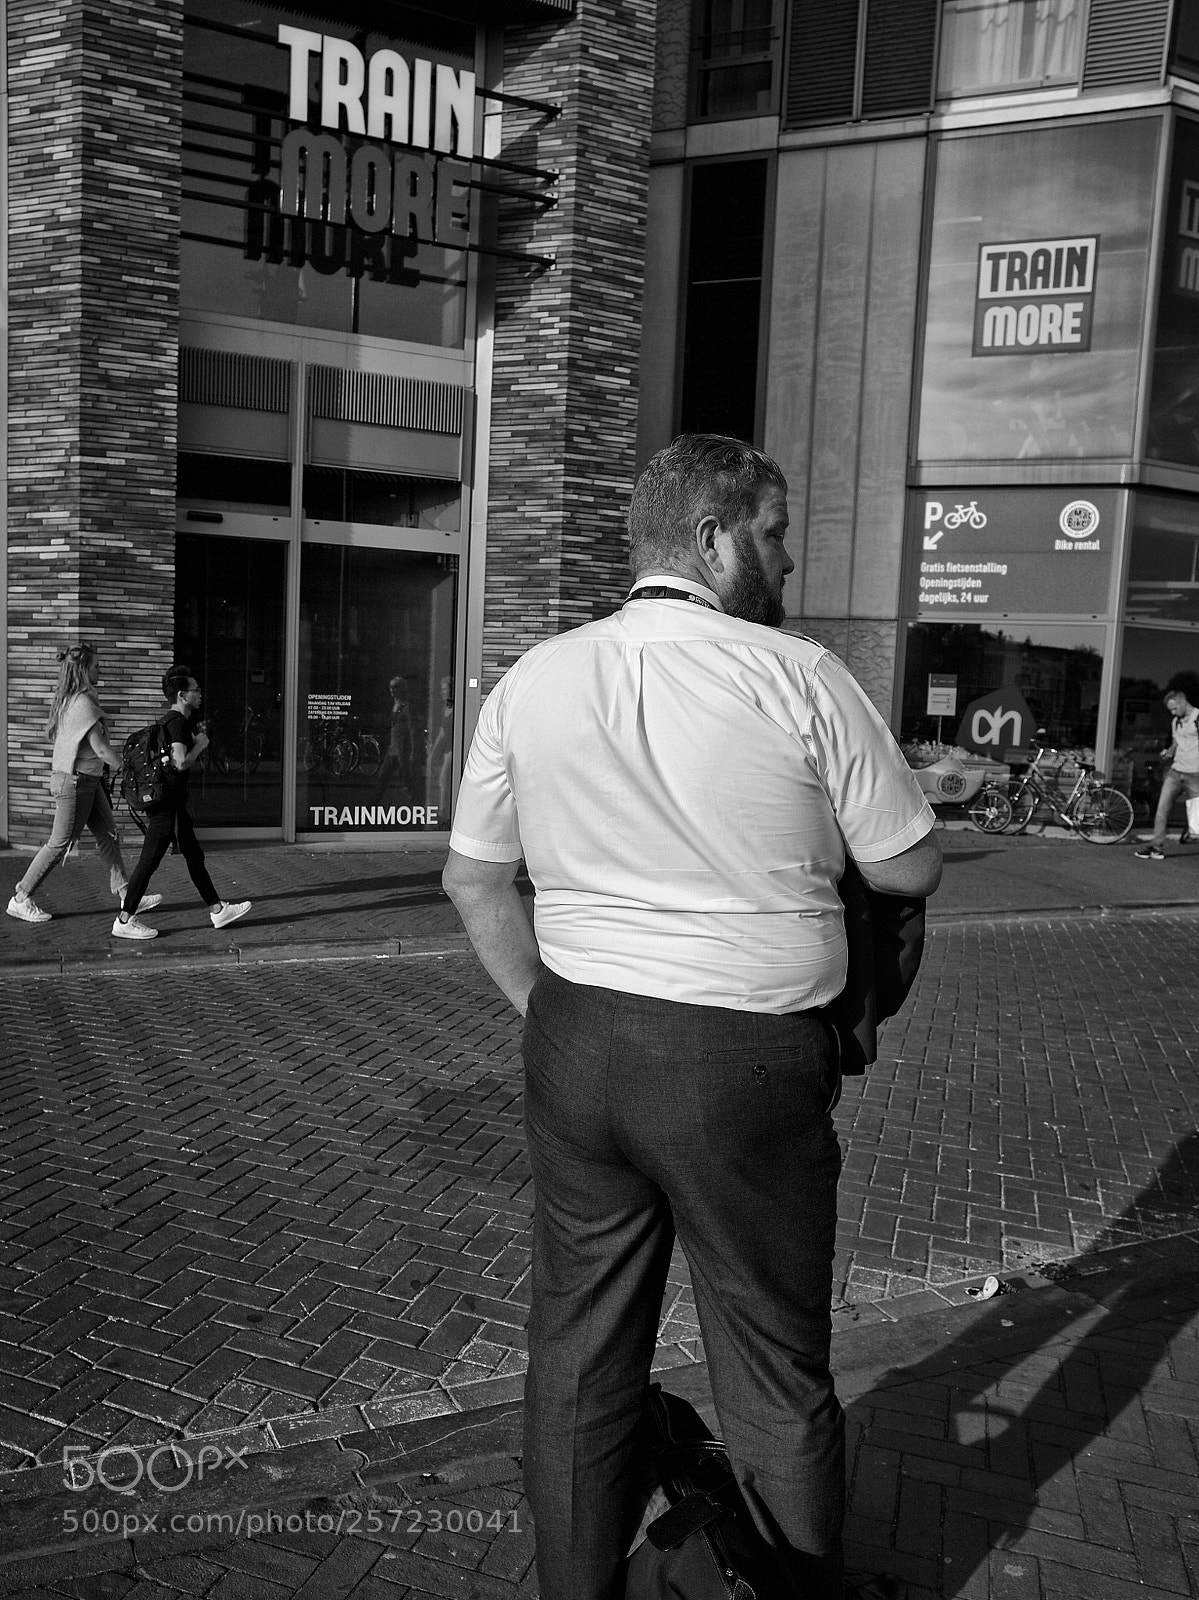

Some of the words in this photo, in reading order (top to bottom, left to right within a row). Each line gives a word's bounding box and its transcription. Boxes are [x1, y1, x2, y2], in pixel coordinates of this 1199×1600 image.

[278, 24, 475, 159] TRAIN
[280, 129, 472, 244] MORE
[986, 245, 1089, 293] TRAIN
[982, 302, 1084, 347] MORE
[924, 501, 943, 529] P
[1055, 539, 1073, 550] Bike
[1074, 539, 1100, 550] rental
[921, 562, 945, 572] Gratis
[946, 562, 1008, 575] fietsenstalling
[920, 577, 982, 590] Openingstijden
[919, 591, 959, 605] dagelijks,
[960, 592, 972, 603] 24
[973, 594, 989, 603] uur
[310, 806, 439, 825] TRAINMORE
